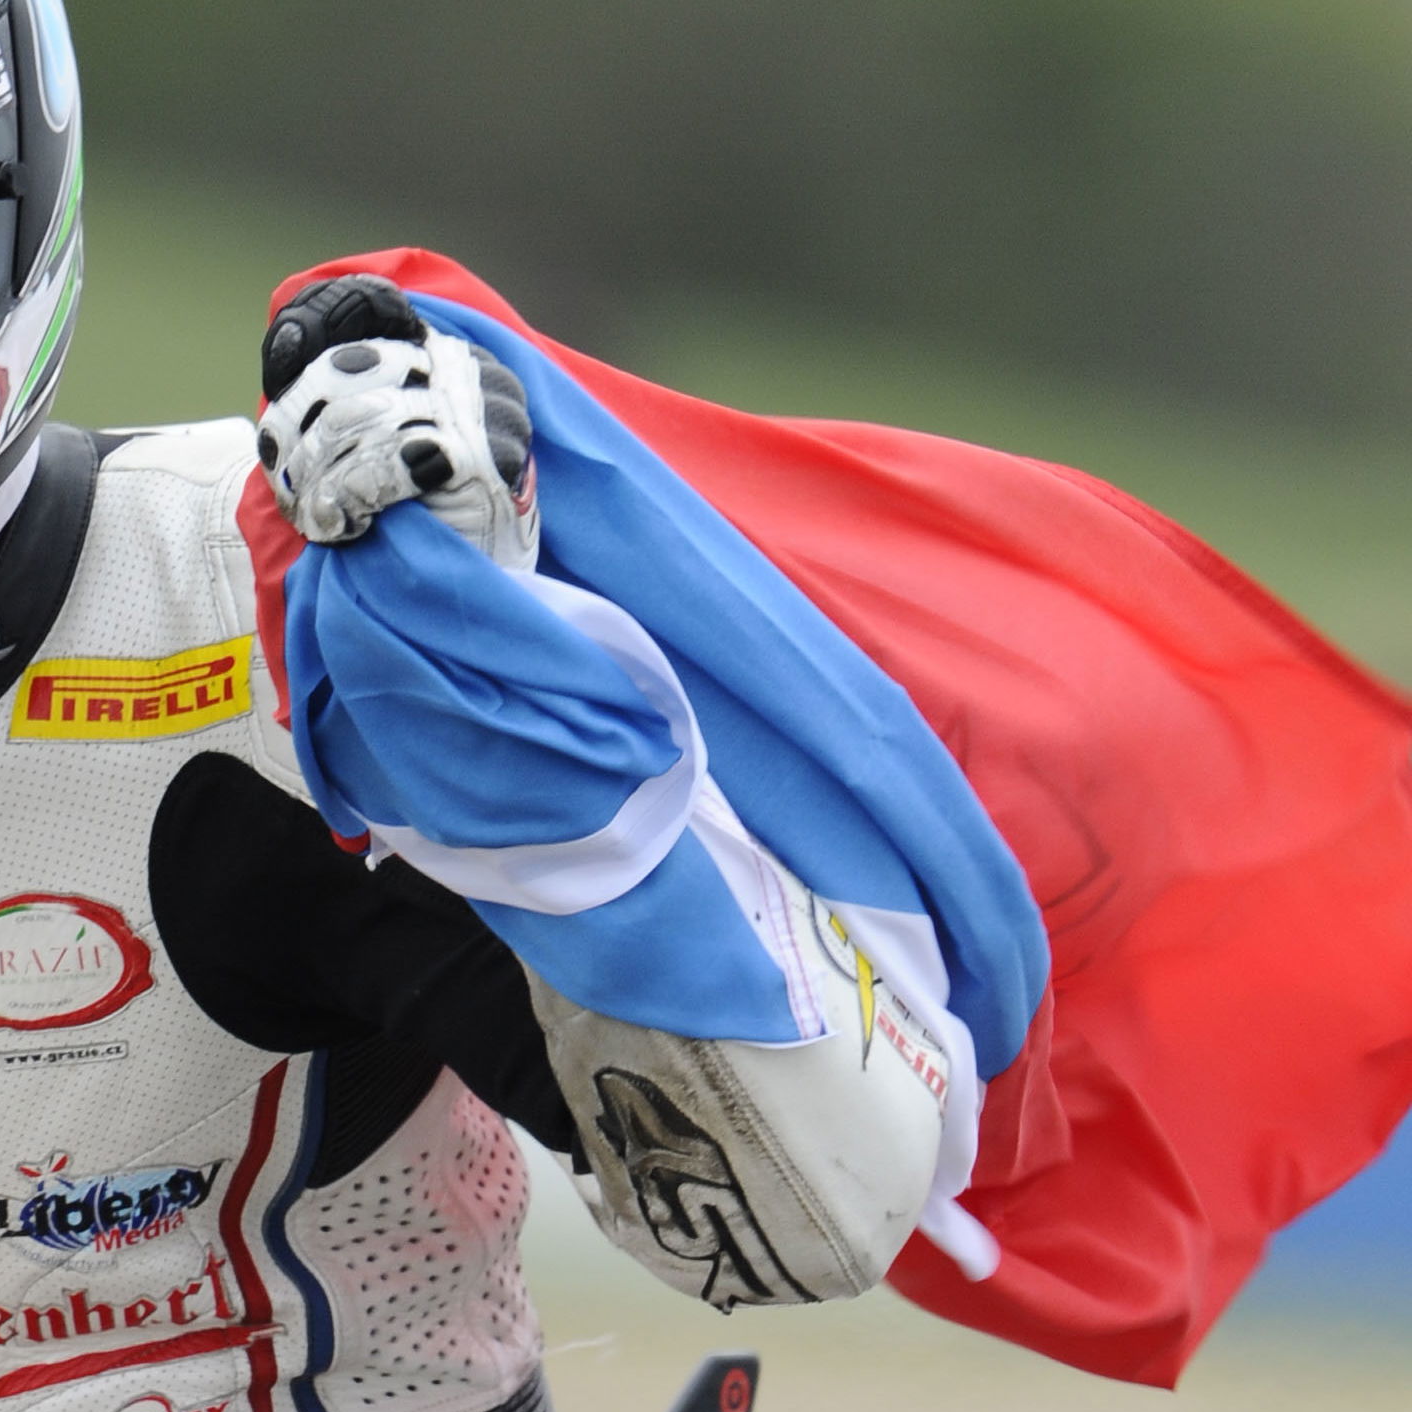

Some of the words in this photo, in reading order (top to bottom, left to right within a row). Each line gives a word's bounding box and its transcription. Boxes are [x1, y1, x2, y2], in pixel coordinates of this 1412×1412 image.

[26, 656, 236, 722] PIRELLI
[4, 1045, 122, 1064] www.grazie.cz
[92, 1207, 186, 1253] Media
